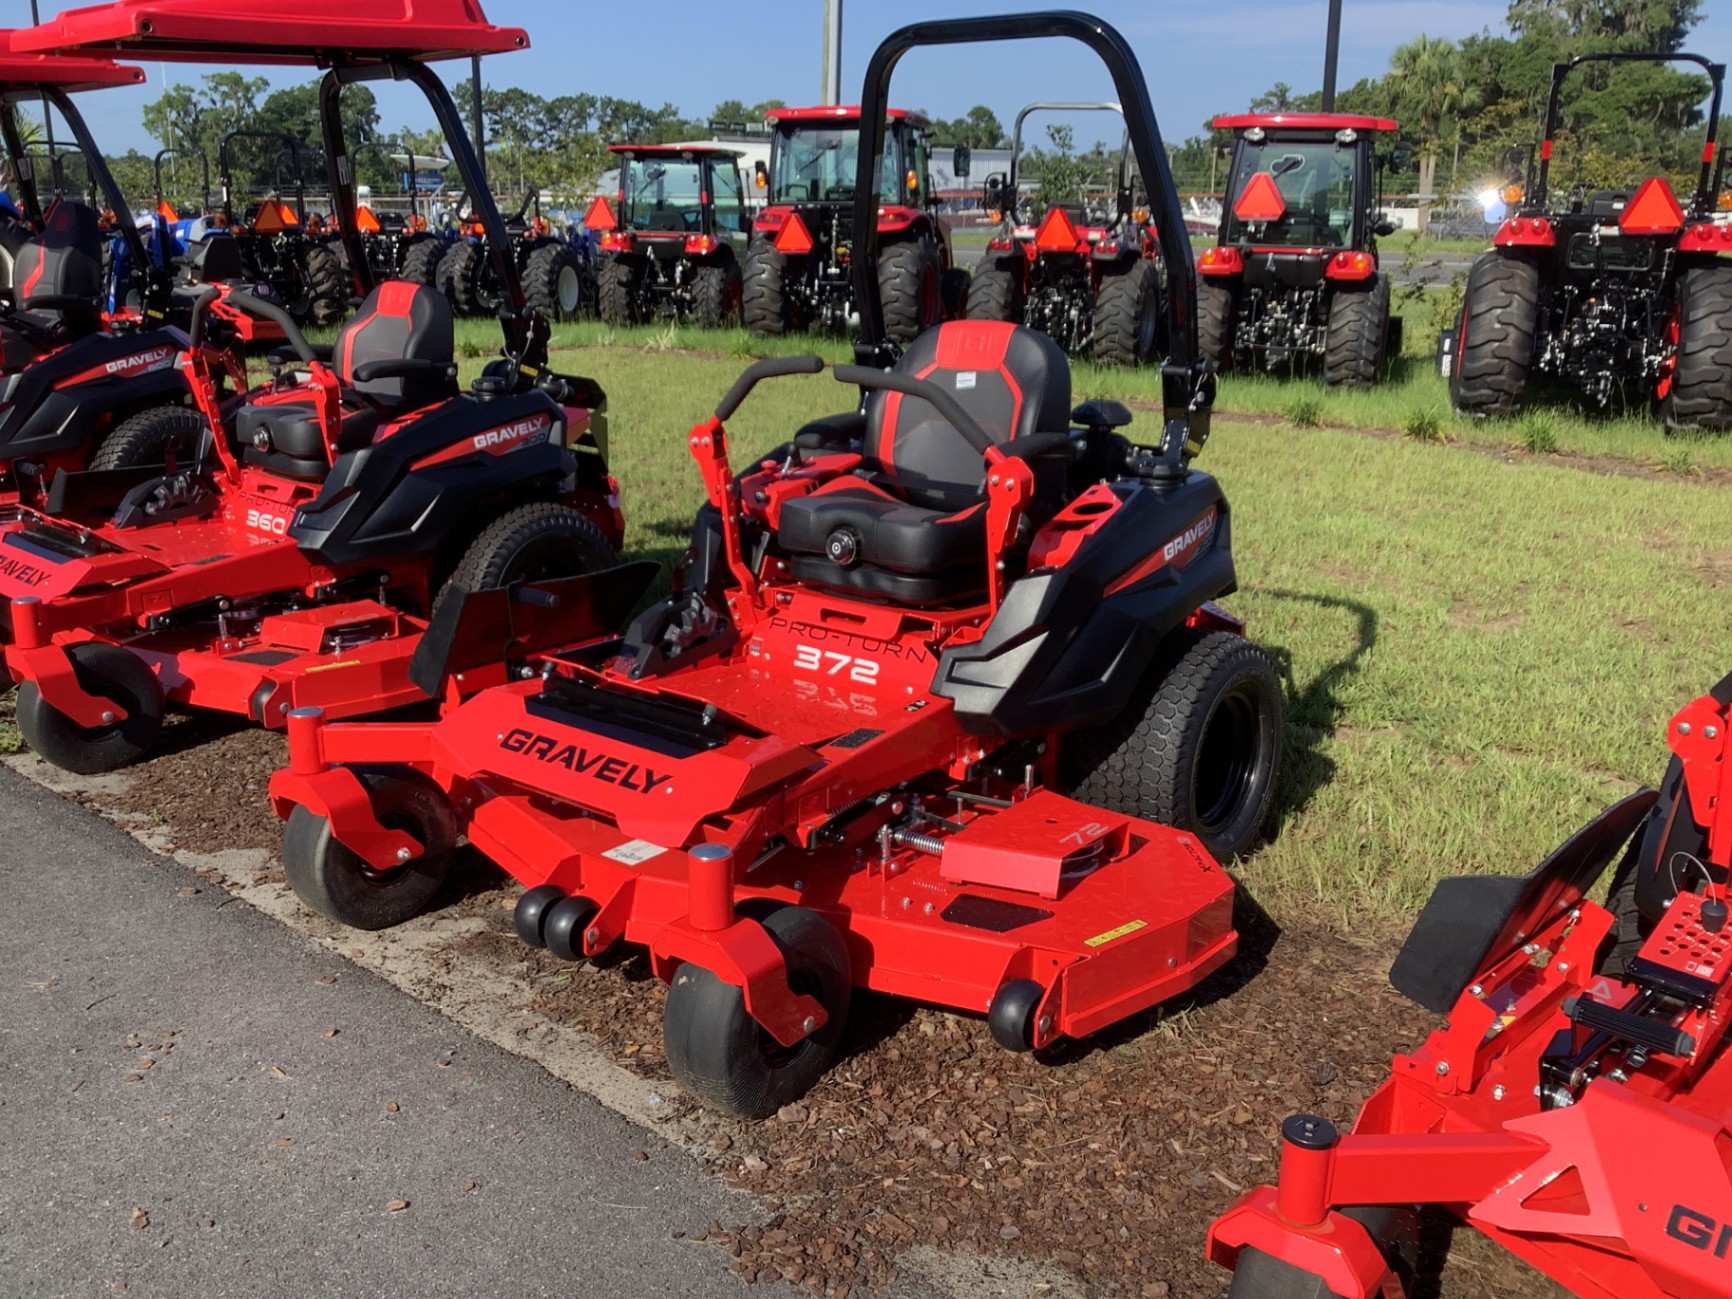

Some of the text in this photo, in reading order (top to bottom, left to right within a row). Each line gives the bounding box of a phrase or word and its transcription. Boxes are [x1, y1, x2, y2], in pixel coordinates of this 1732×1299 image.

[105, 349, 167, 373] GRAVELY
[473, 417, 543, 449] GRAVELY
[246, 509, 286, 535] 360
[1163, 510, 1214, 561] GRAVELY
[769, 617, 927, 664] PRO-TURN
[793, 644, 880, 686] 372
[499, 728, 674, 795] GRAVELY
[1058, 822, 1109, 846] 72
